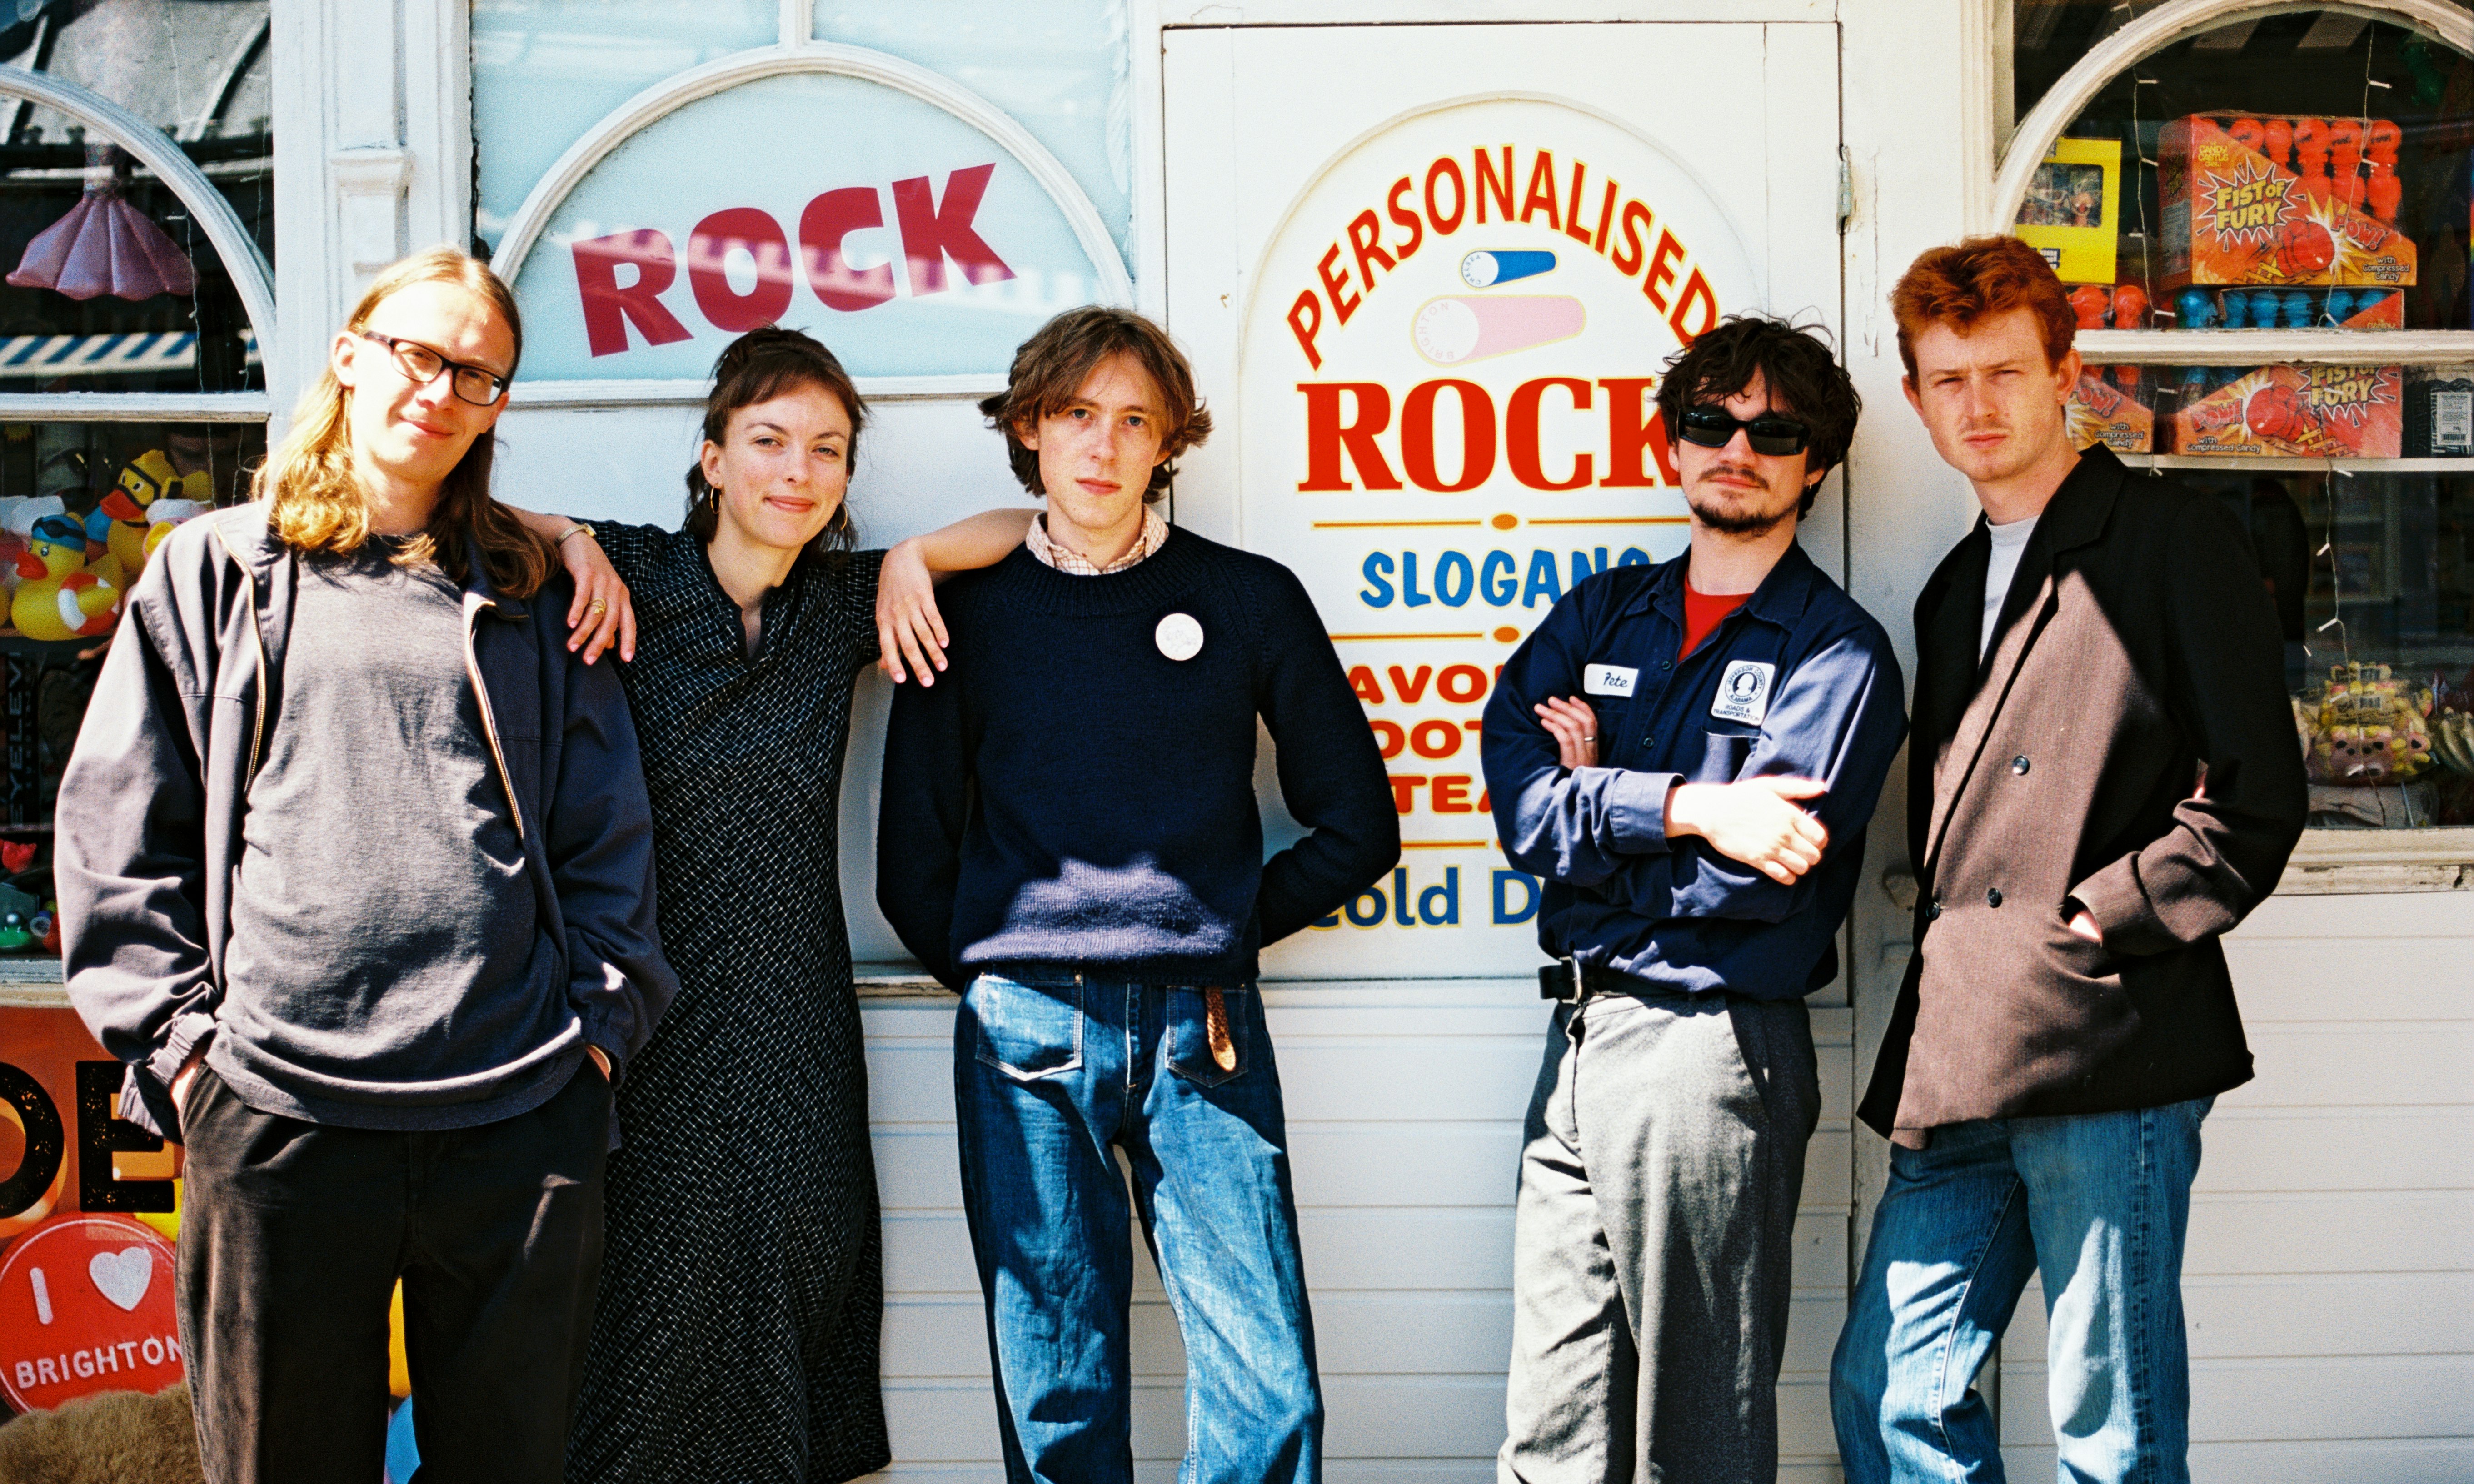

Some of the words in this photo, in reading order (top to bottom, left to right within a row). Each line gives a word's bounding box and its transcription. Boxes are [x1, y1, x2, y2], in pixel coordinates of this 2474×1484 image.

[2216, 179, 2267, 210] FIST
[2265, 180, 2286, 198] OF
[2217, 201, 2282, 230] FURY
[2331, 214, 2386, 251] POW!
[571, 162, 1017, 357] ROCK
[1287, 146, 1717, 371] PERSONALISED
[1464, 254, 1481, 285] CHELSEA
[2363, 264, 2409, 274] Compressed
[2375, 272, 2400, 282] Candy
[1418, 301, 1454, 359] BRIGHTON
[2075, 382, 2121, 417] OW!
[2311, 378, 2374, 406] FURY
[2192, 398, 2243, 431] POW!
[1296, 377, 1682, 492] ROCK
[2095, 430, 2144, 441] Compressed
[2107, 438, 2133, 448] Candy
[2186, 443, 2234, 453] Compressed
[2235, 444, 2261, 454] Candy
[2197, 436, 2218, 444] with
[1603, 672, 1628, 687] Pete
[1754, 668, 1763, 689] COUNTY
[1726, 704, 1744, 712] ROADS
[1730, 694, 1753, 703] ALABAMA
[1713, 708, 1760, 722] TRANSPORTATION
[30, 1267, 53, 1325] I
[15, 1335, 183, 1389] BRIGHTON
